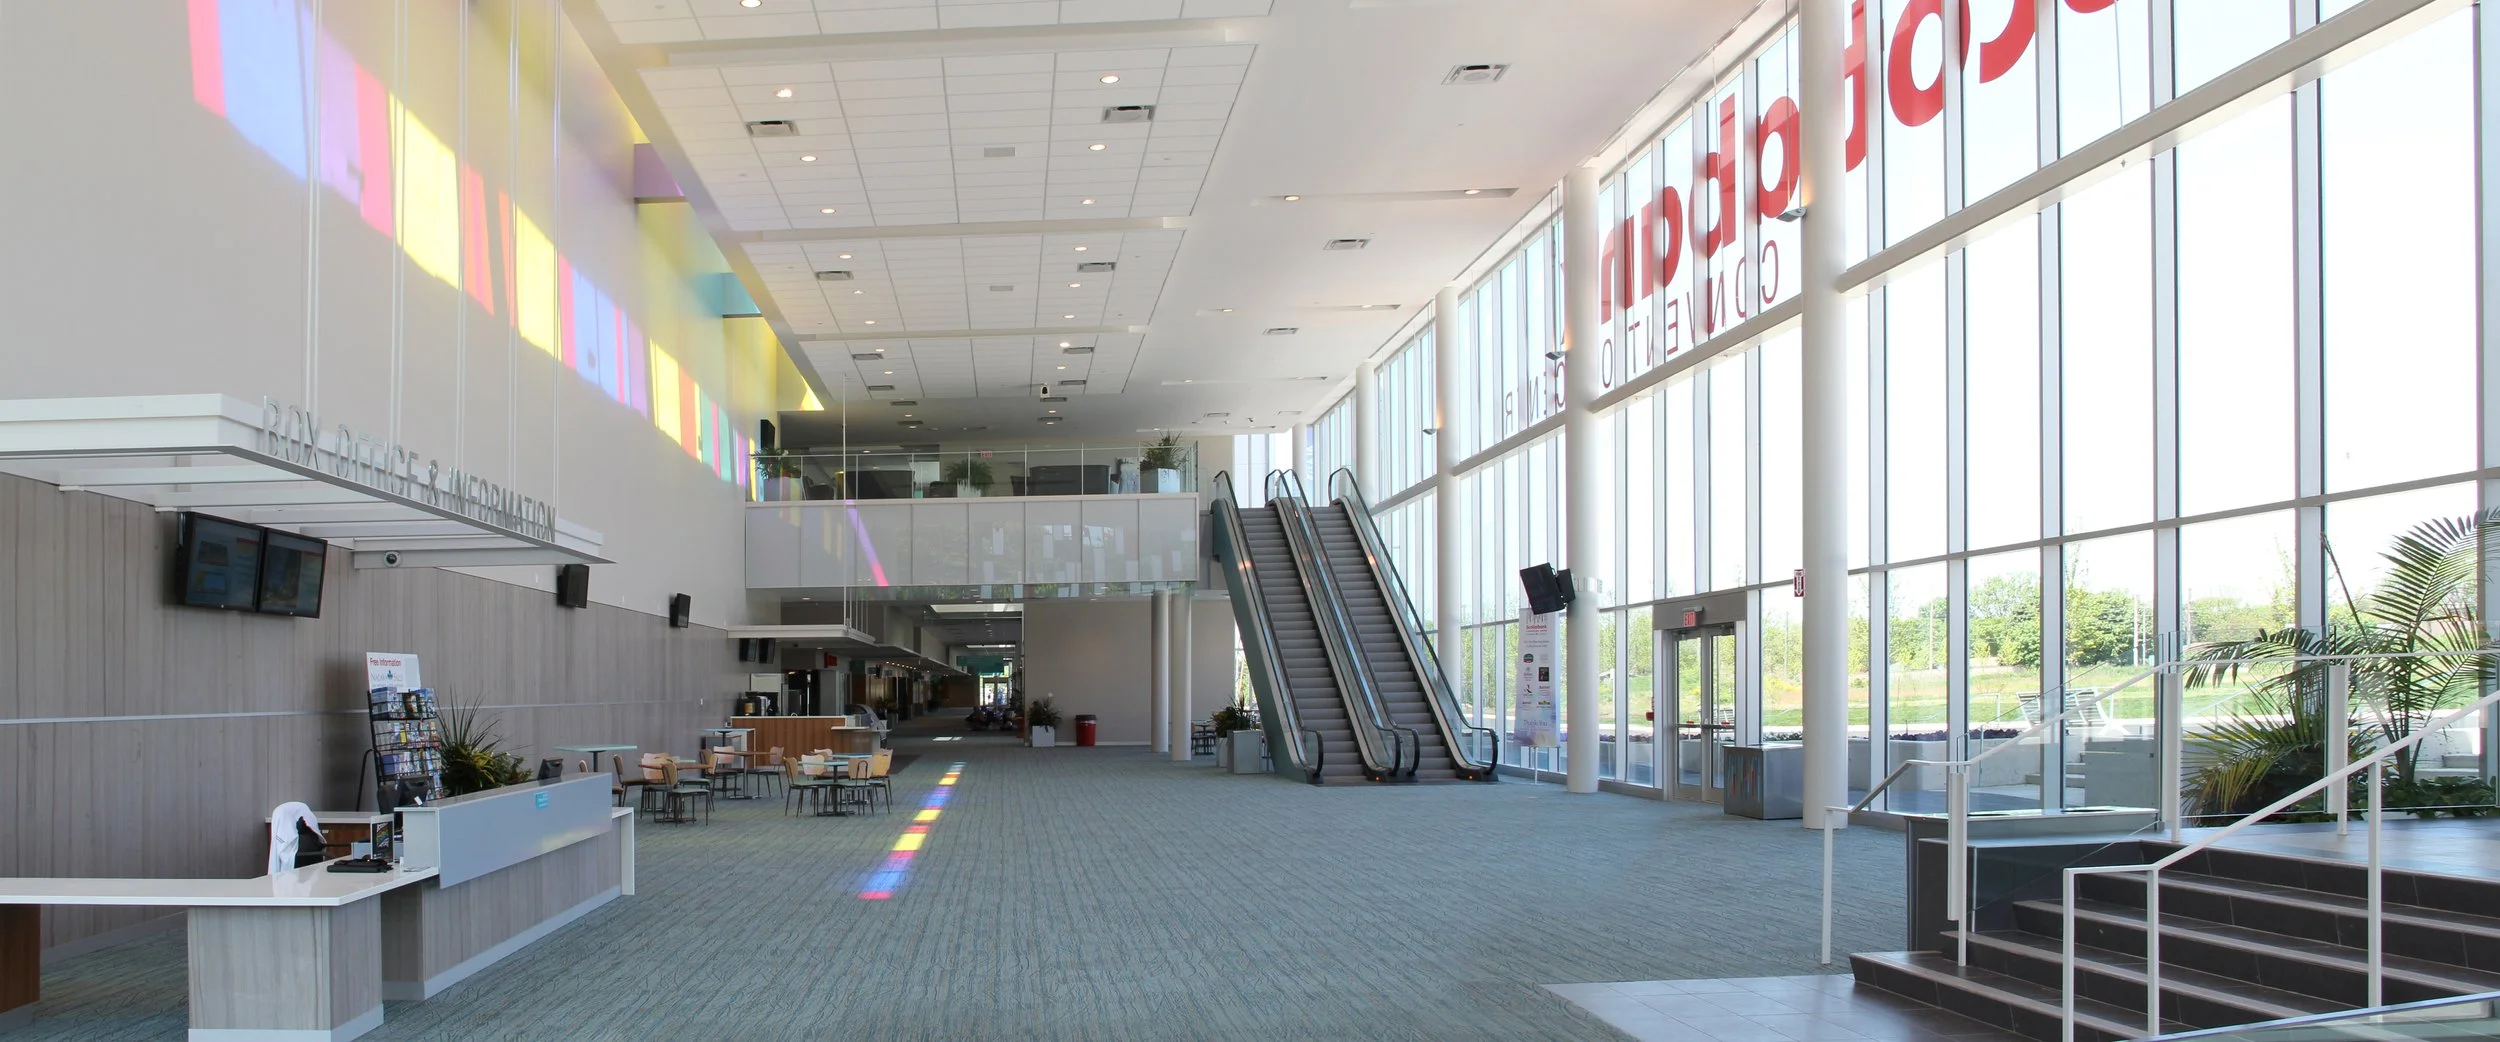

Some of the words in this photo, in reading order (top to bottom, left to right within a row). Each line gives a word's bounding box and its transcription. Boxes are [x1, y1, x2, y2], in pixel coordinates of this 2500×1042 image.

[263, 395, 321, 471] BOX
[336, 423, 419, 499] OFFICE
[427, 459, 440, 506] &
[449, 466, 556, 544] INFORMATION
[370, 657, 379, 666] Free
[380, 658, 401, 667] Information
